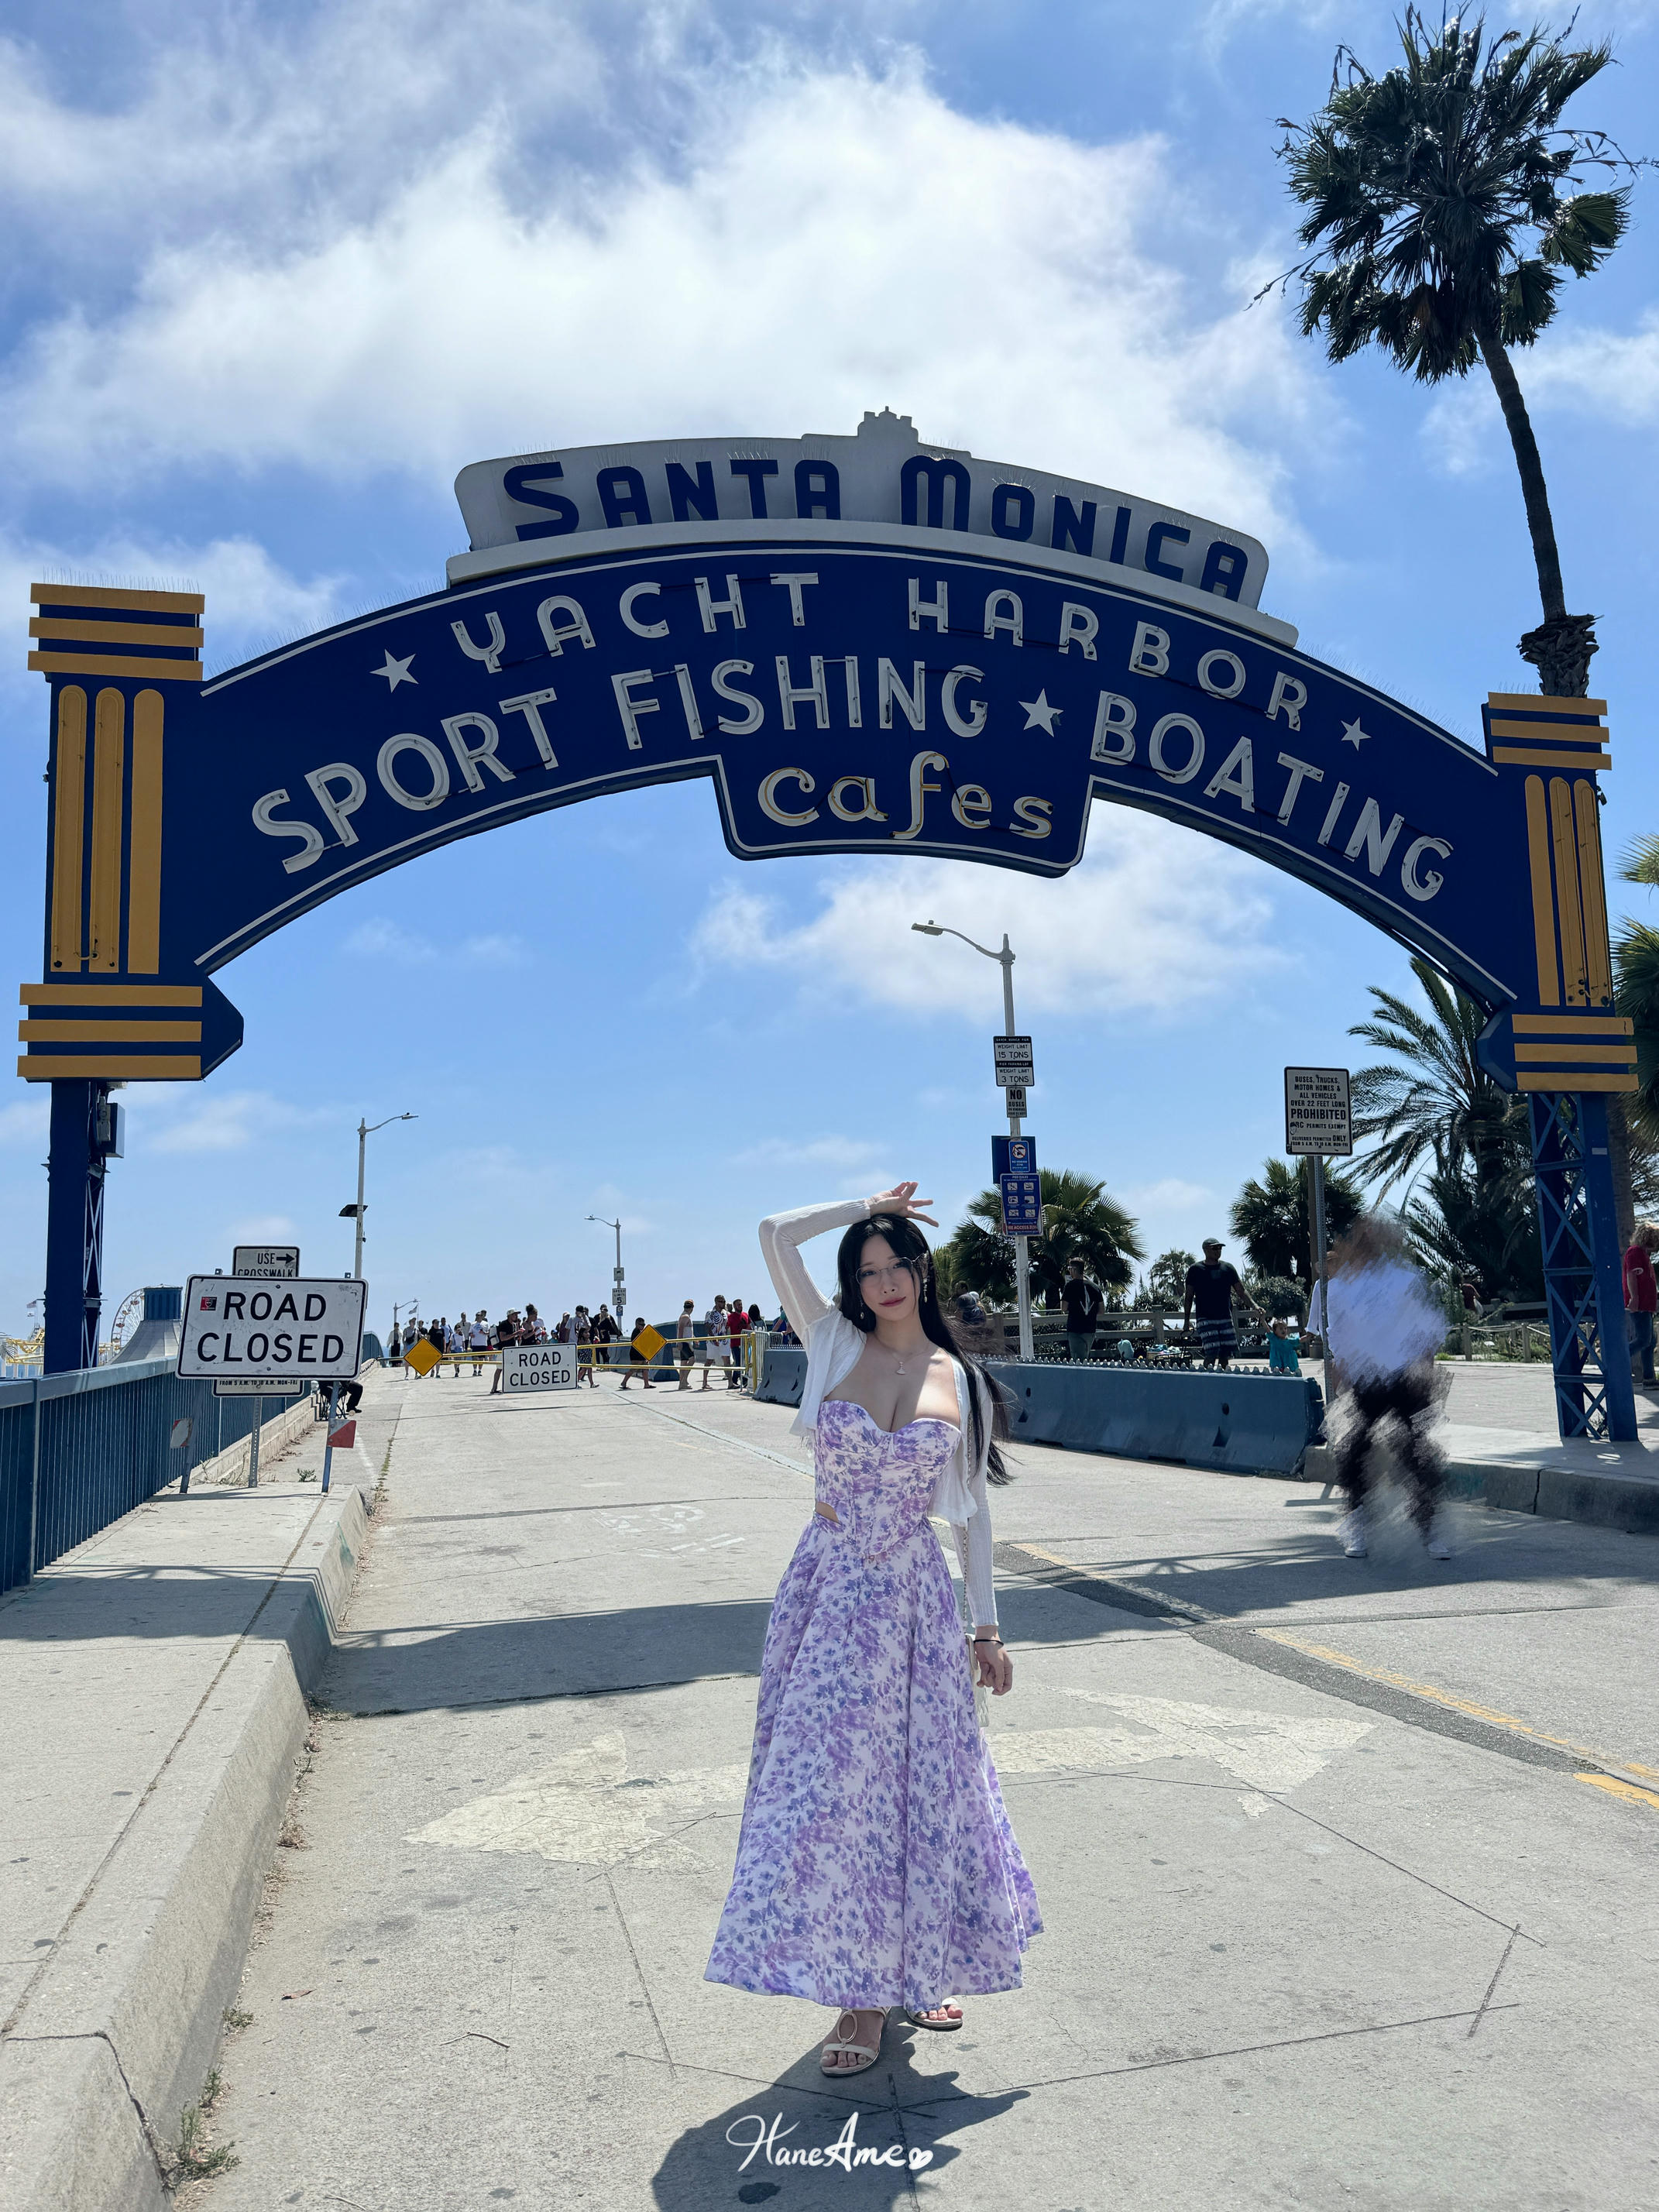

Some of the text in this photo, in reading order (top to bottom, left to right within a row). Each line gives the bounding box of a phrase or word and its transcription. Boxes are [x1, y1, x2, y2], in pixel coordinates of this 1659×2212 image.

[503, 455, 1248, 602] SANTA MONICA
[451, 573, 1307, 731] YACHT HARBOR
[252, 656, 1454, 902] SPORT FISHING BOATING
[1009, 1089, 1022, 1100] NO
[1290, 1108, 1346, 1120] PROHIBITED
[257, 1253, 276, 1265] USE
[238, 1269, 294, 1277] CROSSWALK
[223, 1292, 327, 1321] ROAD
[198, 1332, 344, 1363] CLOSED
[518, 1351, 562, 1367] ROAD
[510, 1369, 571, 1386] CLOSED
